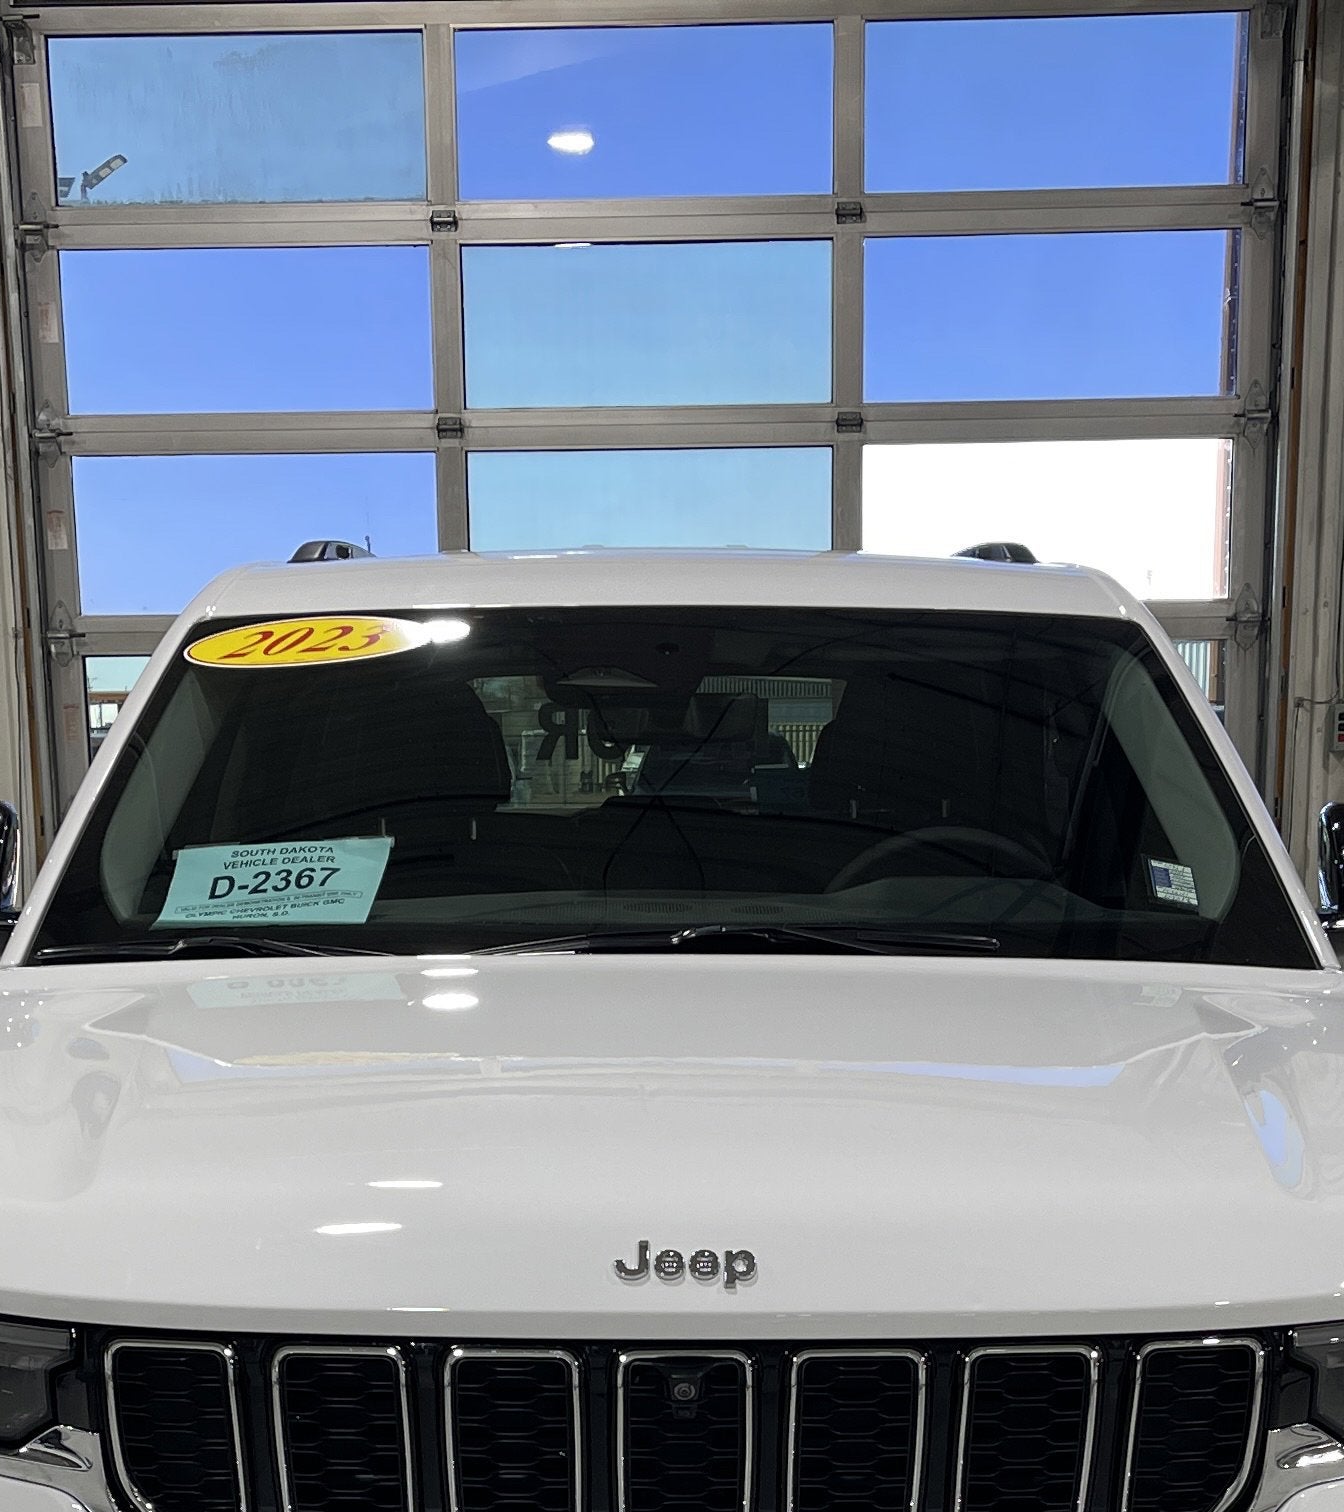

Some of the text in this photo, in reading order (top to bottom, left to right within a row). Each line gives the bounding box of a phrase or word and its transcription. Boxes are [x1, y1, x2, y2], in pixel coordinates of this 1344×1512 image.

[217, 624, 393, 660] 2023
[223, 855, 336, 870] VEHICLE DEALER
[231, 845, 335, 858] SOUTH DAKOTA
[208, 867, 341, 900] D-2367
[229, 903, 289, 914] CHEVROLET
[290, 901, 320, 909] BUICK
[322, 898, 346, 906] GMC
[614, 1240, 757, 1290] Jeep
